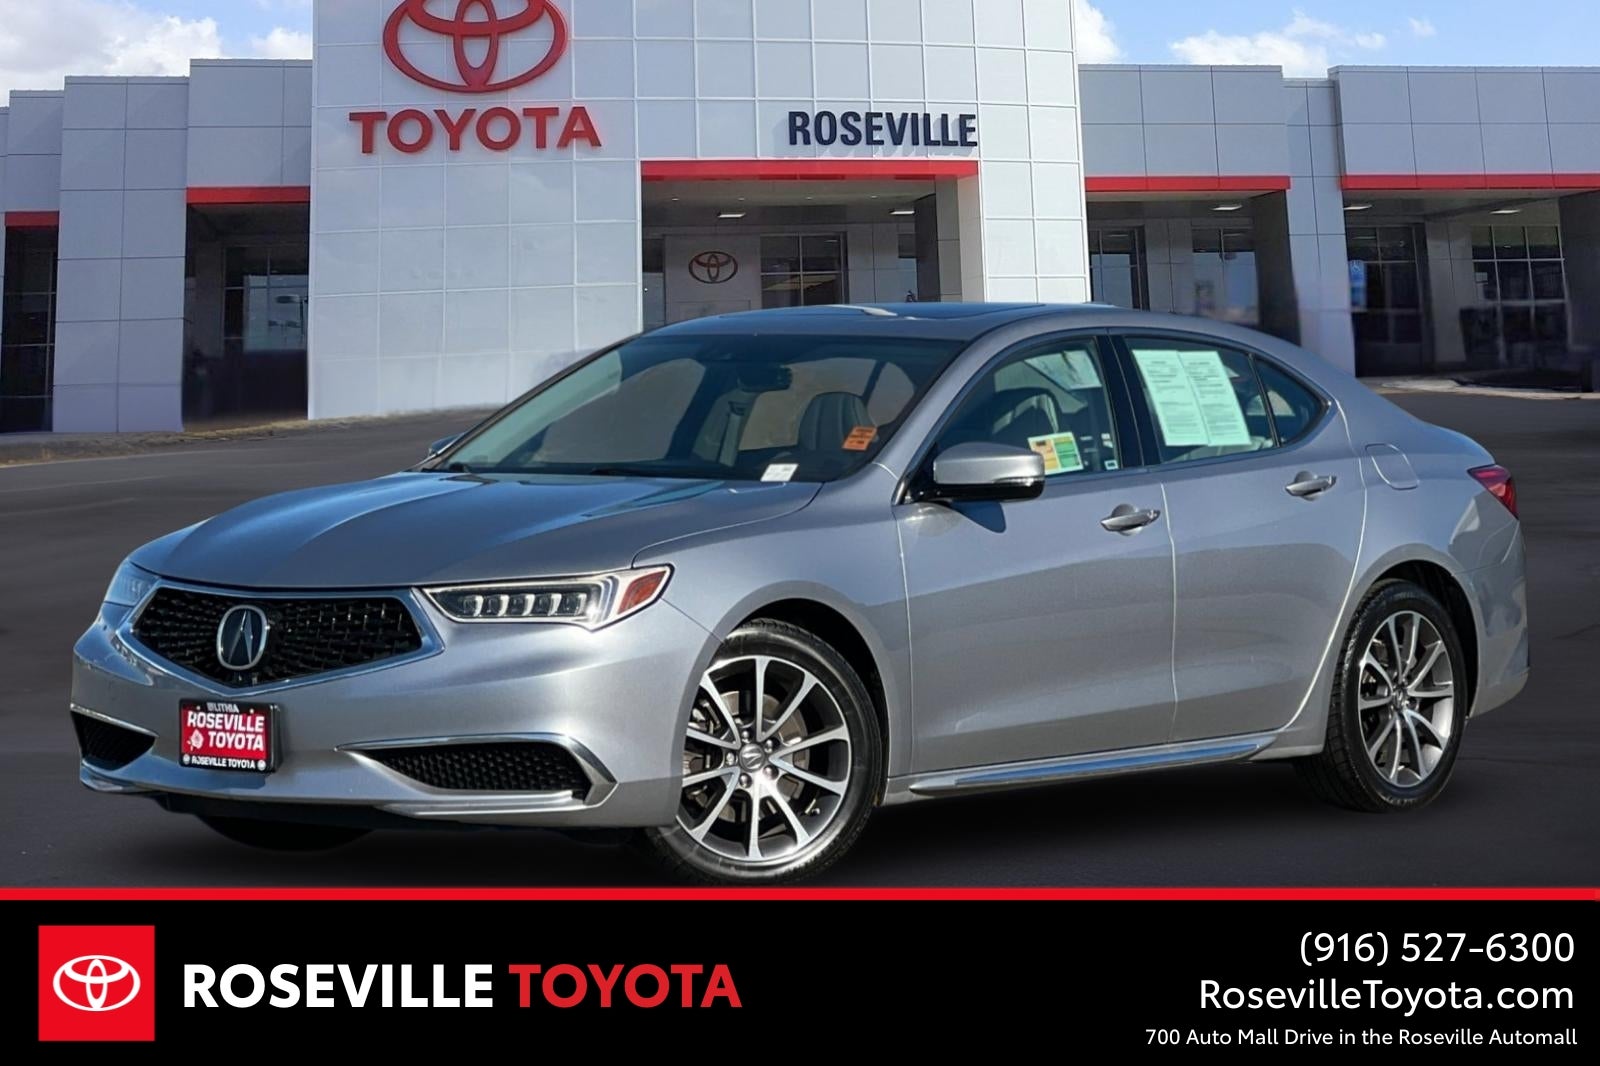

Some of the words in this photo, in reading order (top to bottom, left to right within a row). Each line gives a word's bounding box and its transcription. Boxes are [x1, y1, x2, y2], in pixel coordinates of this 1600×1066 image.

[349, 106, 602, 154] TOYOTA
[788, 111, 978, 147] ROSEVILLE
[187, 710, 265, 733] ROSEVILLE
[208, 731, 265, 751] TOYOTA
[191, 755, 227, 767] ROSEVILLE
[228, 758, 256, 769] TOYOTA
